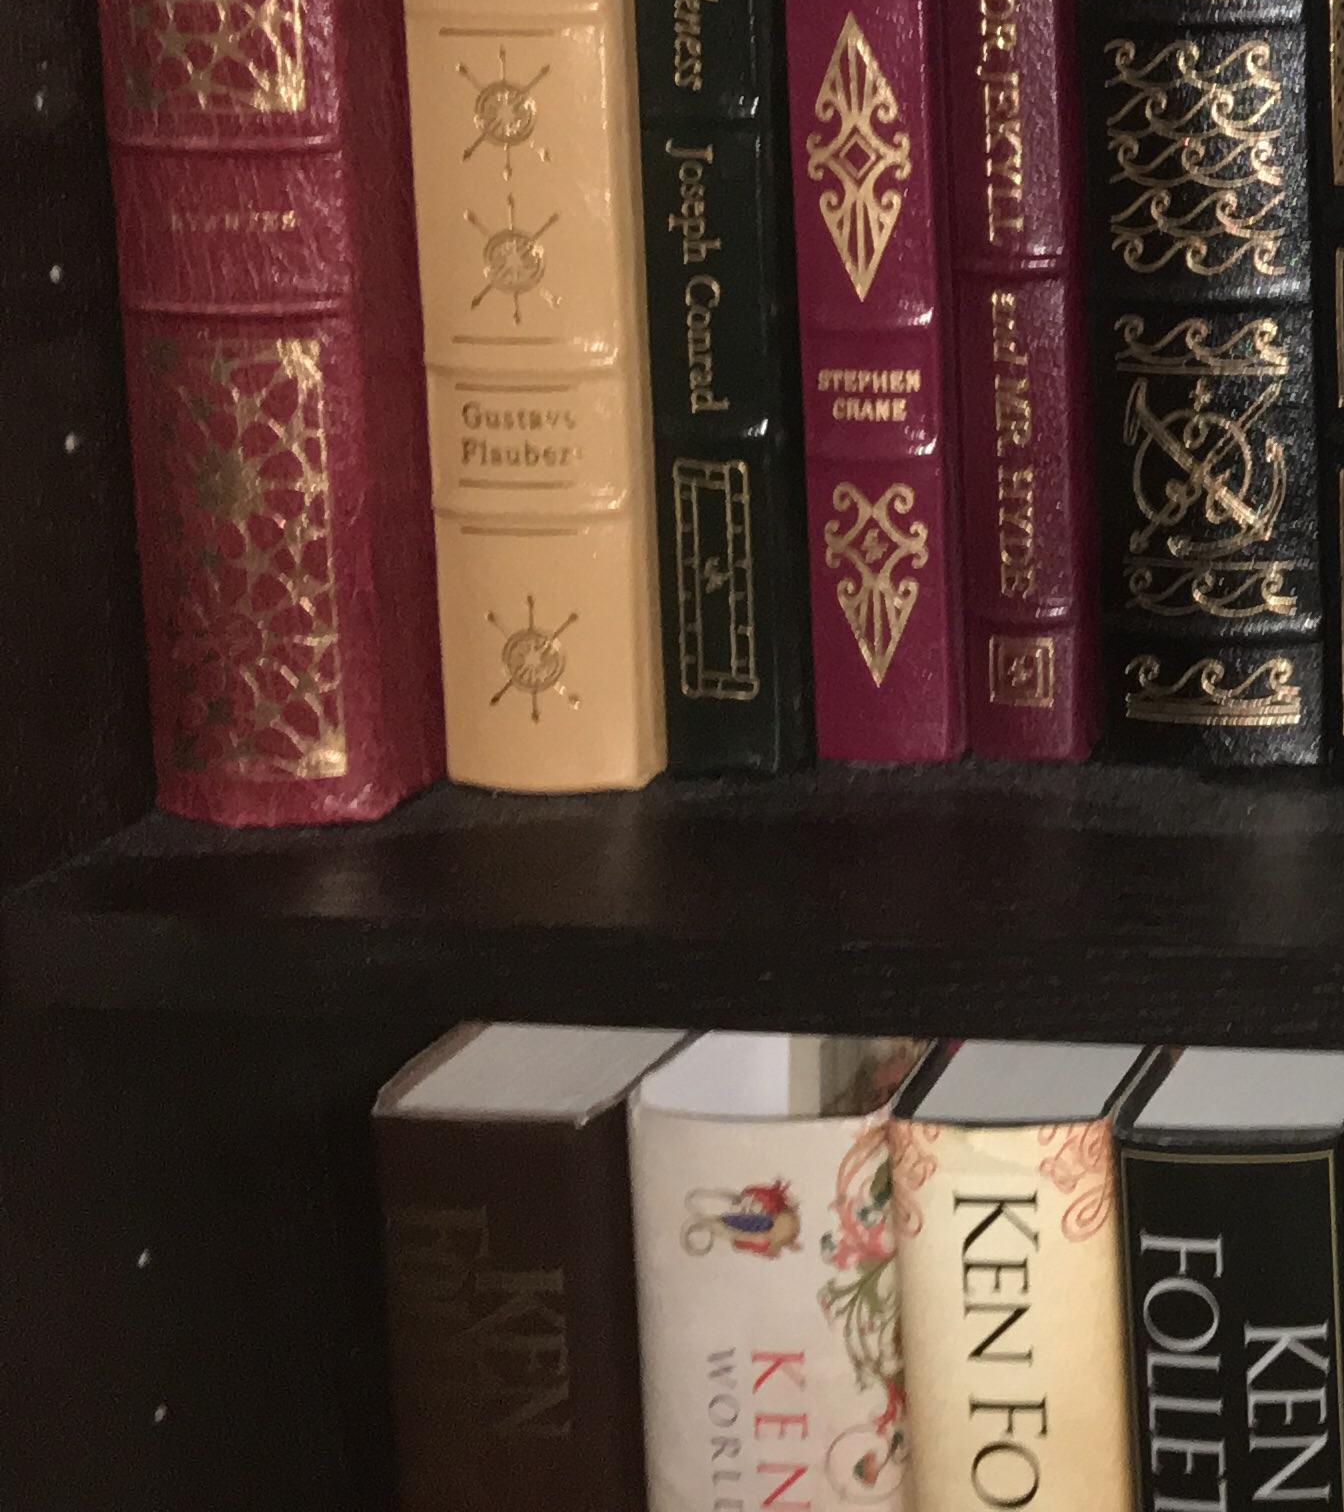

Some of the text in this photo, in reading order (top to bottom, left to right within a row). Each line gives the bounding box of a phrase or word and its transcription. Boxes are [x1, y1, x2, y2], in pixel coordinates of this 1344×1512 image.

[664, 138, 731, 414] Joseph Conrad
[817, 369, 921, 393] STEPHEN
[832, 397, 907, 422] CRANE
[751, 1349, 812, 1512] KEN
[953, 1189, 1049, 1512] KEN FO
[1243, 1318, 1332, 1503] KEN
